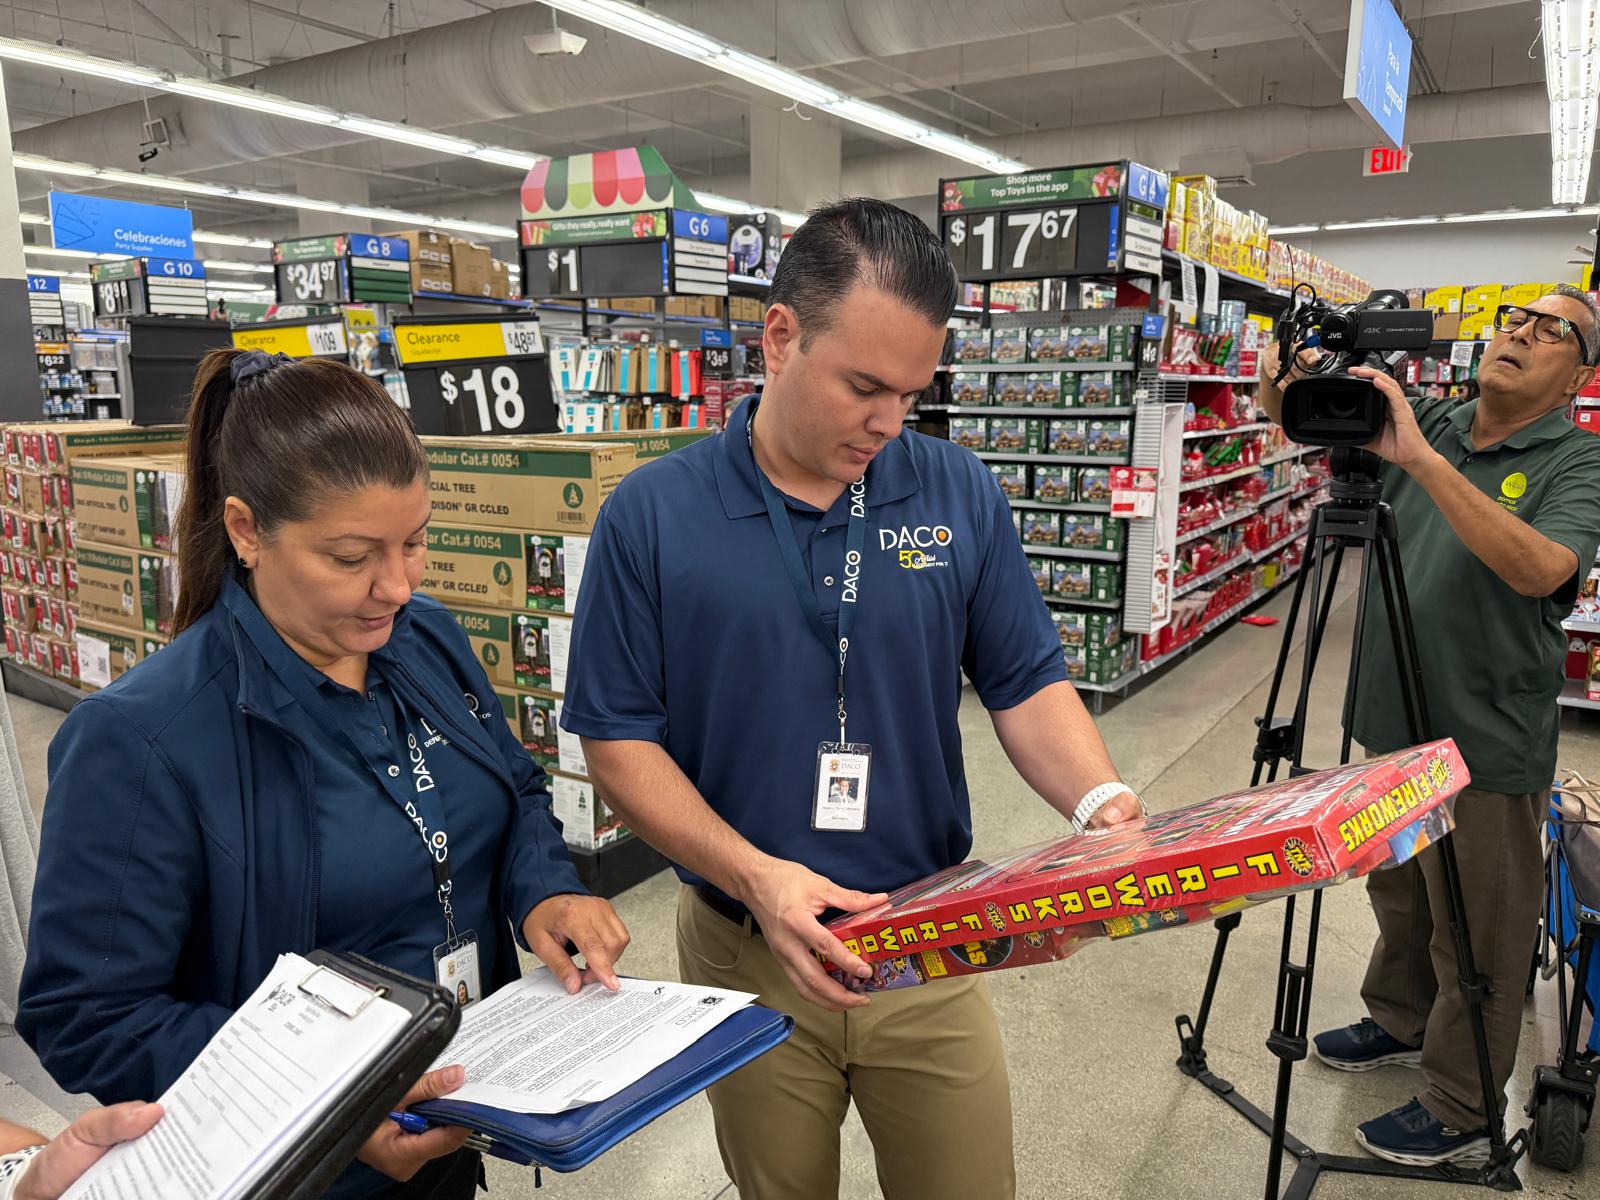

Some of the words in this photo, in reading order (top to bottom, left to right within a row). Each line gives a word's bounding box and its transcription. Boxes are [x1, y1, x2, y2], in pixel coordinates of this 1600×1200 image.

[1370, 146, 1402, 173] EXIT
[1006, 175, 1028, 185] Shop
[1028, 173, 1052, 183] more
[1138, 175, 1147, 196] G
[1149, 179, 1157, 201] 4
[990, 188, 1006, 198] Top
[1006, 186, 1026, 196] Toys
[1035, 183, 1051, 193] the
[1051, 183, 1069, 193] app
[689, 217, 700, 235] G
[701, 218, 710, 236] 6
[114, 228, 187, 248] Celebraciones
[367, 239, 379, 255] G
[381, 241, 391, 257] 8
[163, 261, 176, 275] G
[179, 263, 193, 276] 10
[547, 249, 578, 292] $1
[33, 279, 47, 290] 12
[407, 332, 461, 345] Clearance
[440, 366, 525, 432] $18
[461, 452, 489, 467] Cat.#
[491, 453, 520, 468] 0054
[453, 483, 476, 494] TREE
[464, 502, 478, 513] GR
[442, 532, 471, 547] Cat.#
[473, 535, 501, 550] 0054
[879, 525, 953, 551] DACO
[432, 561, 455, 572] TREE
[899, 549, 926, 570] 50
[442, 580, 456, 591] GR
[841, 550, 861, 603] DACO
[464, 615, 490, 631] 0054
[407, 732, 435, 793] DACO
[1338, 771, 1434, 853] FIREWORKS
[1289, 845, 1312, 870] TNT
[1007, 851, 1281, 923] FIREWORKS
